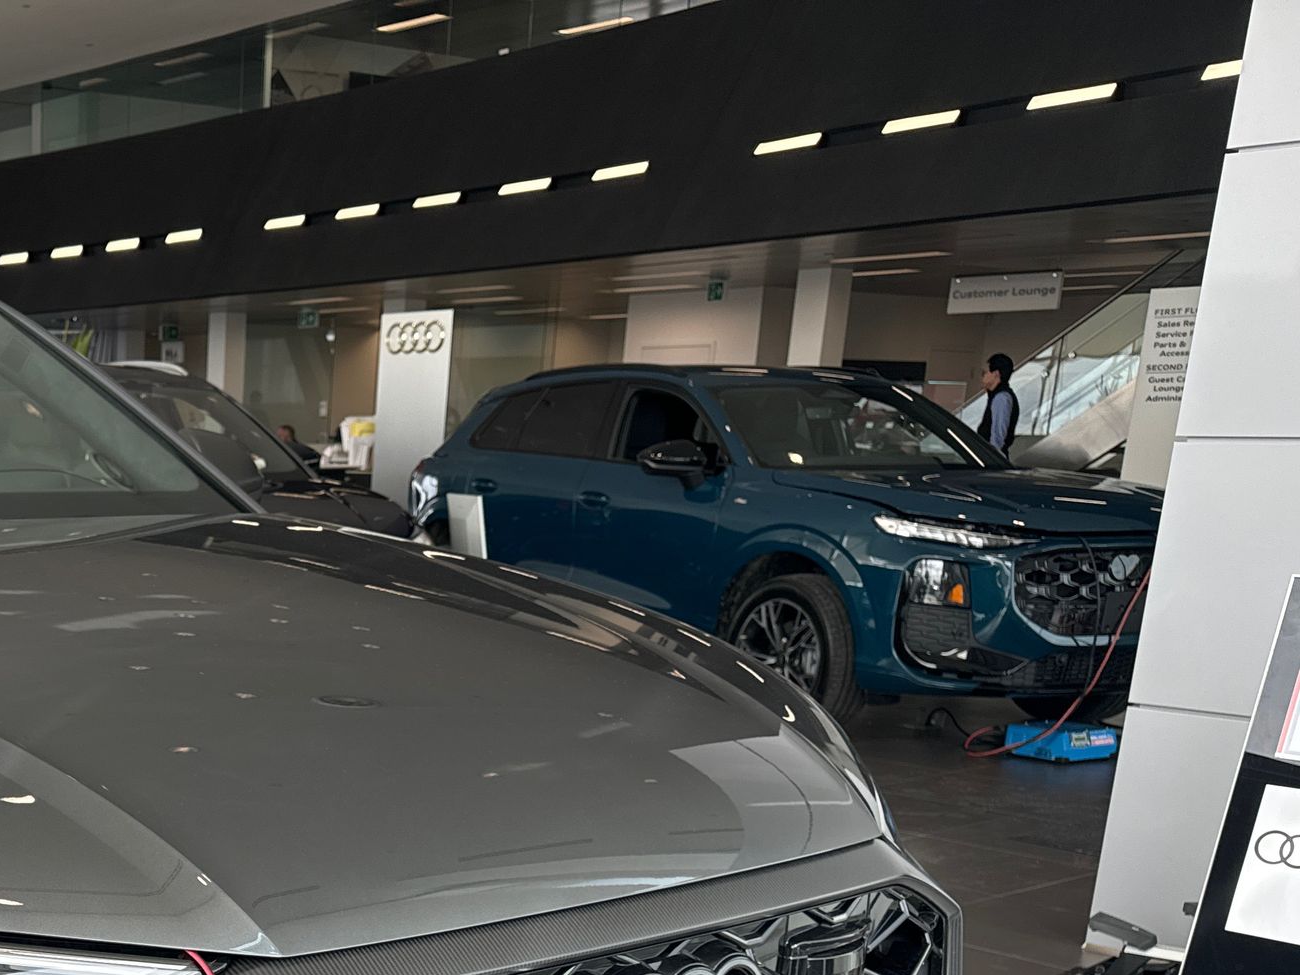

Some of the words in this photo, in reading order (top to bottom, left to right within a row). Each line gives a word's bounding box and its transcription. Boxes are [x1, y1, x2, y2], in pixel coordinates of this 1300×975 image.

[952, 289, 1009, 300] Customer
[1012, 286, 1056, 297] Lounge
[1154, 308, 1182, 316] FIRST
[1157, 320, 1181, 328] Sales
[1148, 376, 1174, 384] Guest
